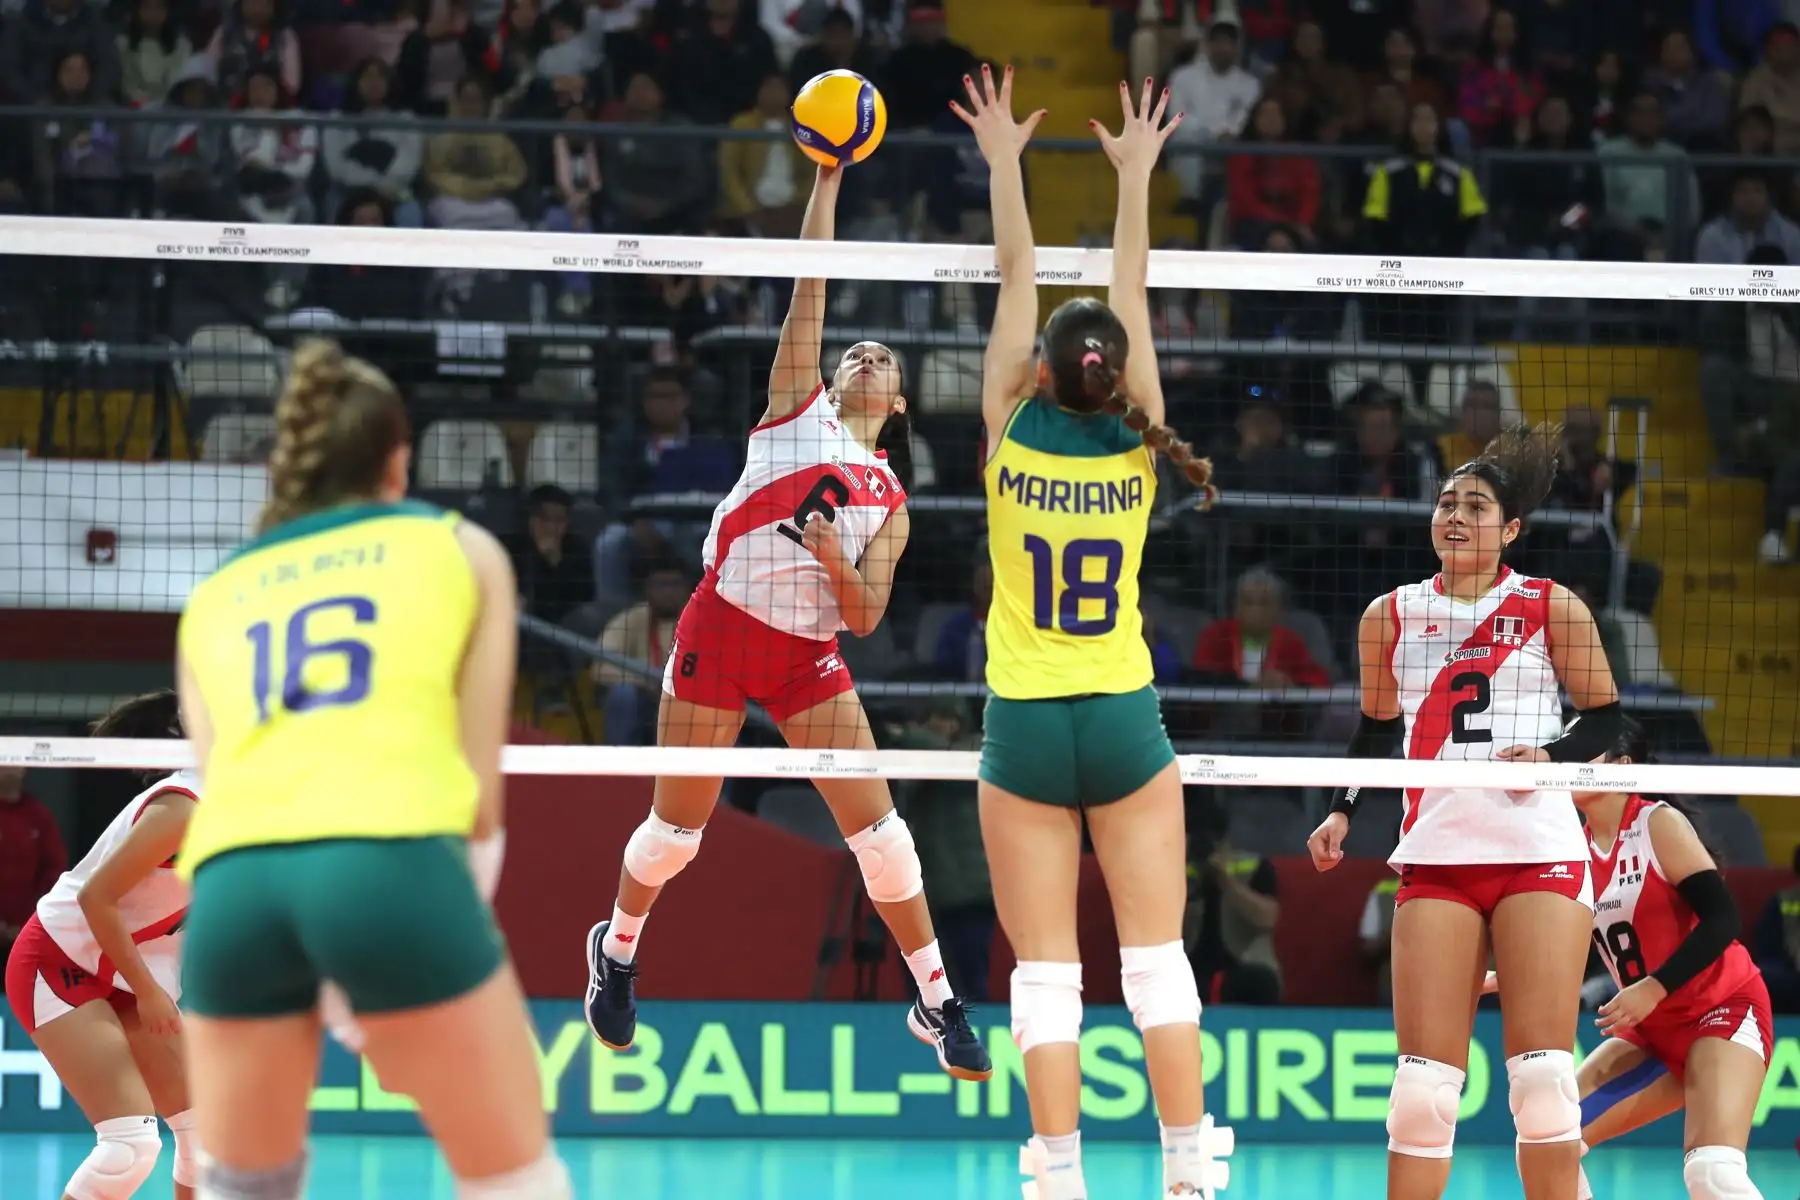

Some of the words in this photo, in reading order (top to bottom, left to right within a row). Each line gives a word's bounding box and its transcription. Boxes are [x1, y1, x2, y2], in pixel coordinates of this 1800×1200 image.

[208, 246, 239, 255] WORLD
[242, 247, 311, 257] CHAMPIONSHIP
[583, 257, 599, 266] U17
[603, 258, 633, 267] WORLD
[636, 258, 703, 269] CHAMPIONSHIP
[1380, 260, 1402, 268] FIVB
[963, 269, 979, 278] U17
[1035, 270, 1083, 280] MPIONSHIP
[1752, 269, 1774, 278] FIVB
[1346, 278, 1362, 286] U17
[1366, 278, 1396, 287] WORLD
[1398, 279, 1464, 289] CHAMPIONSHIP
[1690, 287, 1716, 296] GIRLS'
[1718, 287, 1734, 296] U17
[1738, 288, 1768, 296] WORLD
[998, 465, 1142, 514] MARIANA
[794, 474, 849, 532] 6
[1024, 533, 1124, 637] 18
[1493, 635, 1522, 647] PER
[245, 595, 378, 726] 16
[1453, 647, 1489, 661] SPORADE
[1451, 671, 1492, 743] 2
[1619, 873, 1642, 887] PER
[1596, 899, 1622, 912] SPORADE
[1592, 921, 1648, 988] 18
